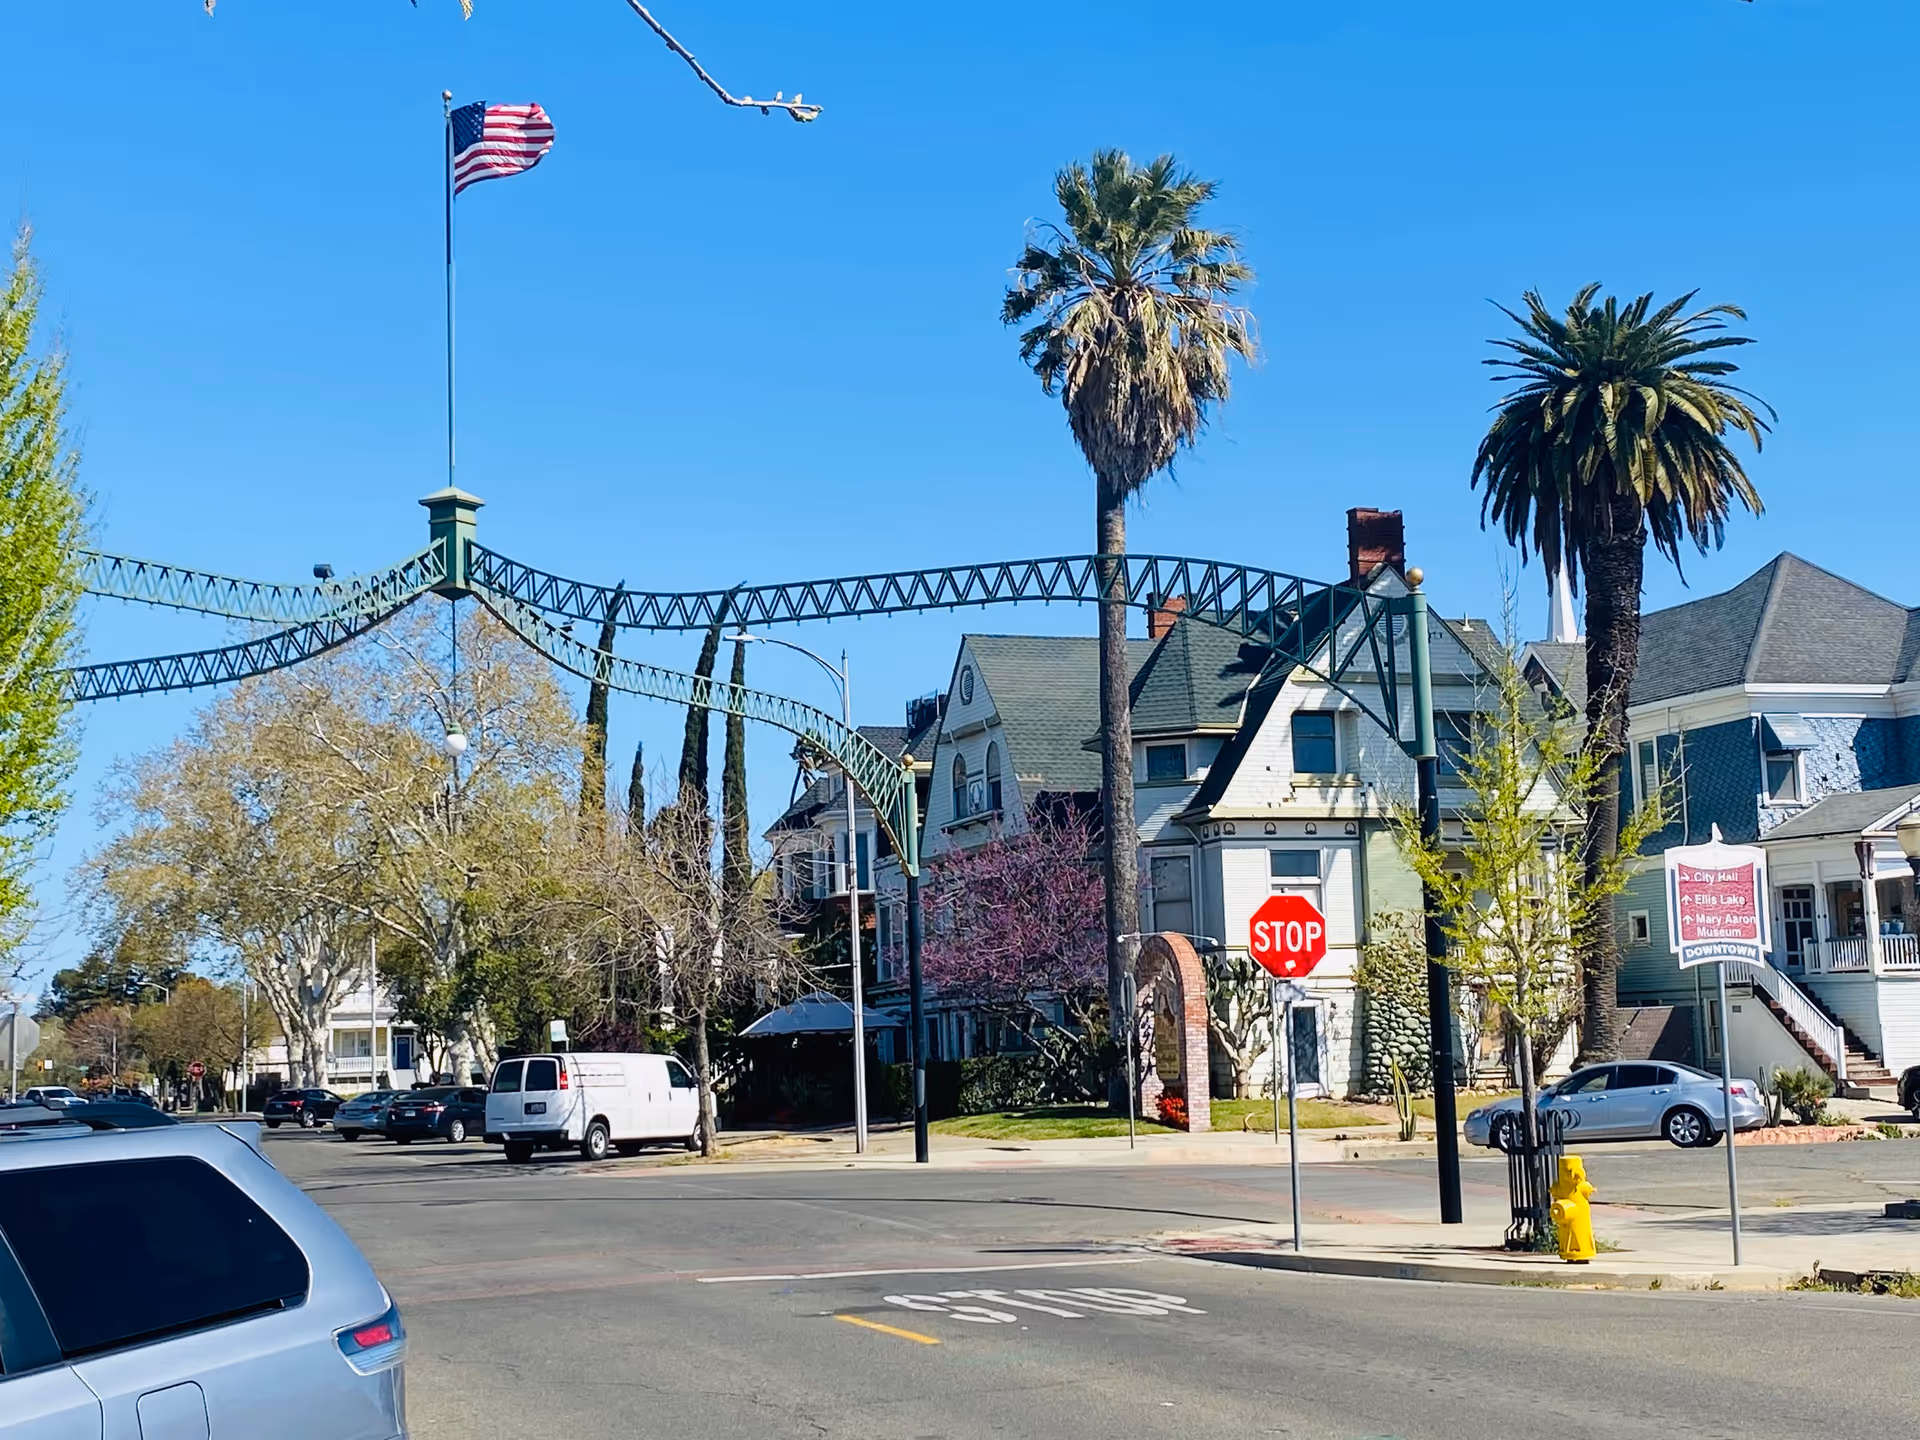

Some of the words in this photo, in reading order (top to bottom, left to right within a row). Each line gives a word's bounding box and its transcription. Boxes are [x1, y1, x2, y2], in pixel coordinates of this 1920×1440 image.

[1694, 872, 1715, 885] City
[1718, 872, 1738, 882] Hall
[1695, 894, 1717, 905] Ellis
[1720, 894, 1746, 905] Lake
[1696, 914, 1722, 926] Mary
[1725, 914, 1757, 924] Aaron
[1254, 920, 1322, 953] STOP
[1697, 926, 1742, 937] Museum
[1685, 944, 1757, 958] DOWNTOWN
[883, 1287, 1209, 1324] STOP
